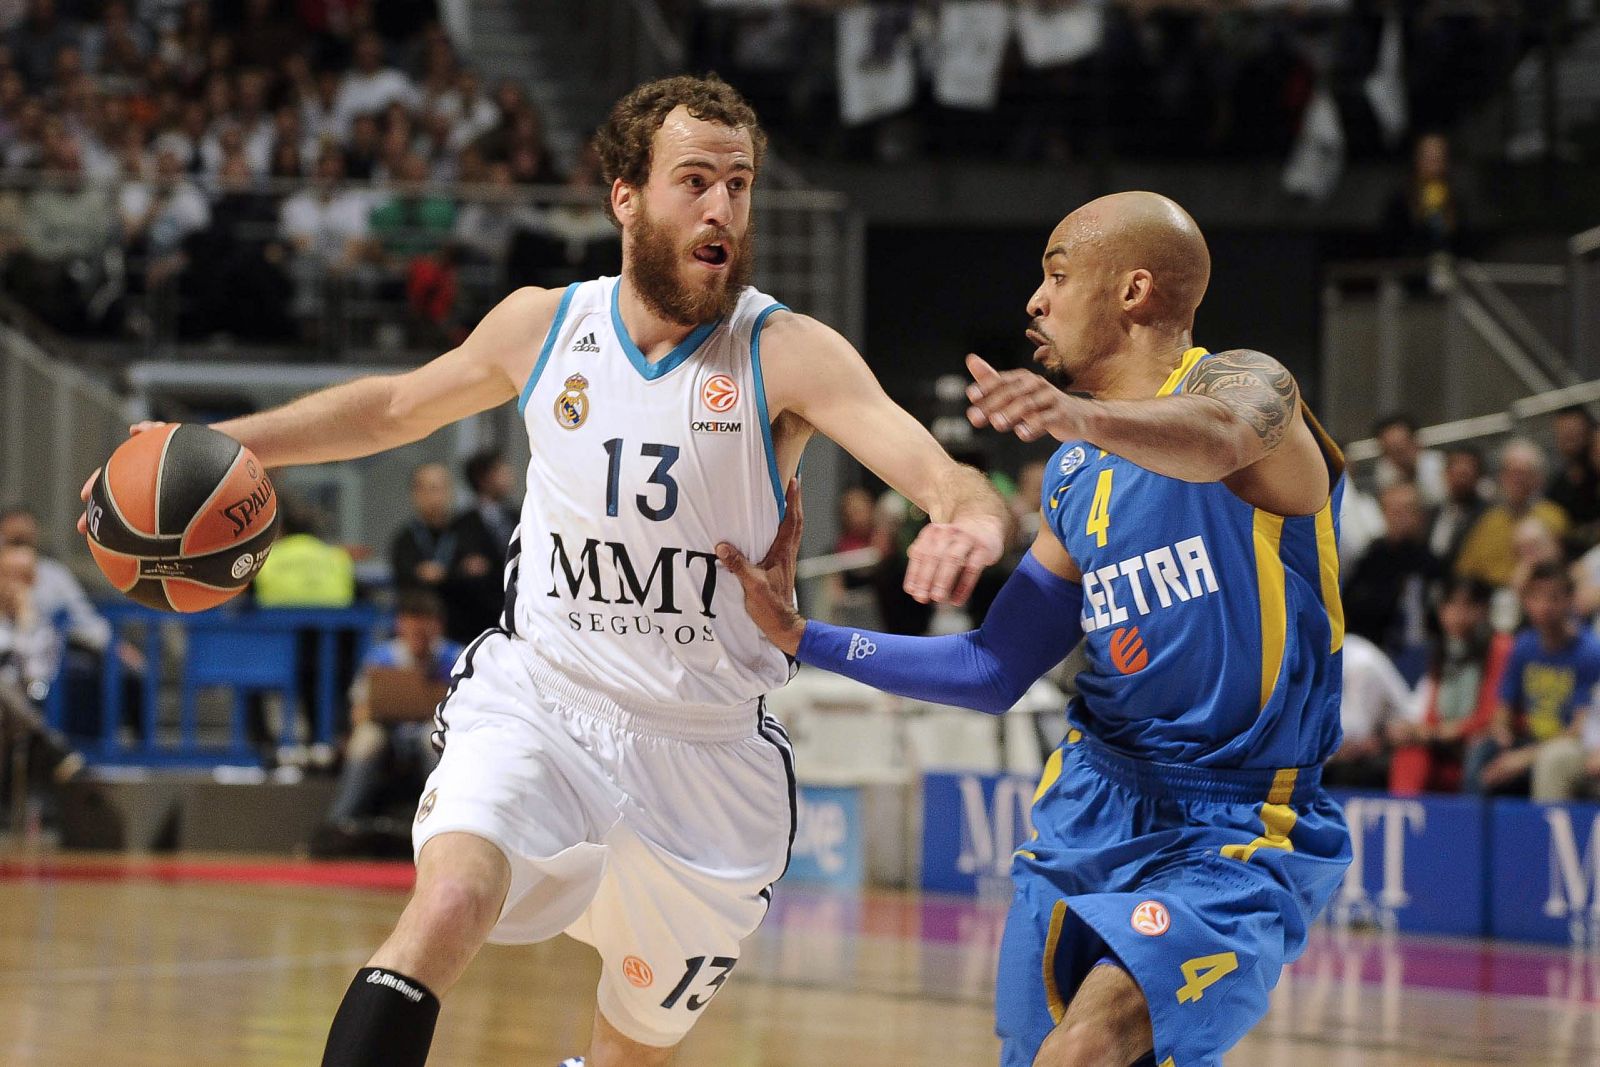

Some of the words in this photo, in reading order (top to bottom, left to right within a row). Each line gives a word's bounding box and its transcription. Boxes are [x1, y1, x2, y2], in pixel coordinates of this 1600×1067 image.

[572, 343, 600, 353] adidas
[602, 438, 680, 522] 13
[1086, 468, 1114, 548] 4
[547, 532, 719, 619] MMT
[568, 611, 714, 645] SEGUOS
[660, 956, 738, 1011] 13
[1175, 952, 1239, 1005] 4
